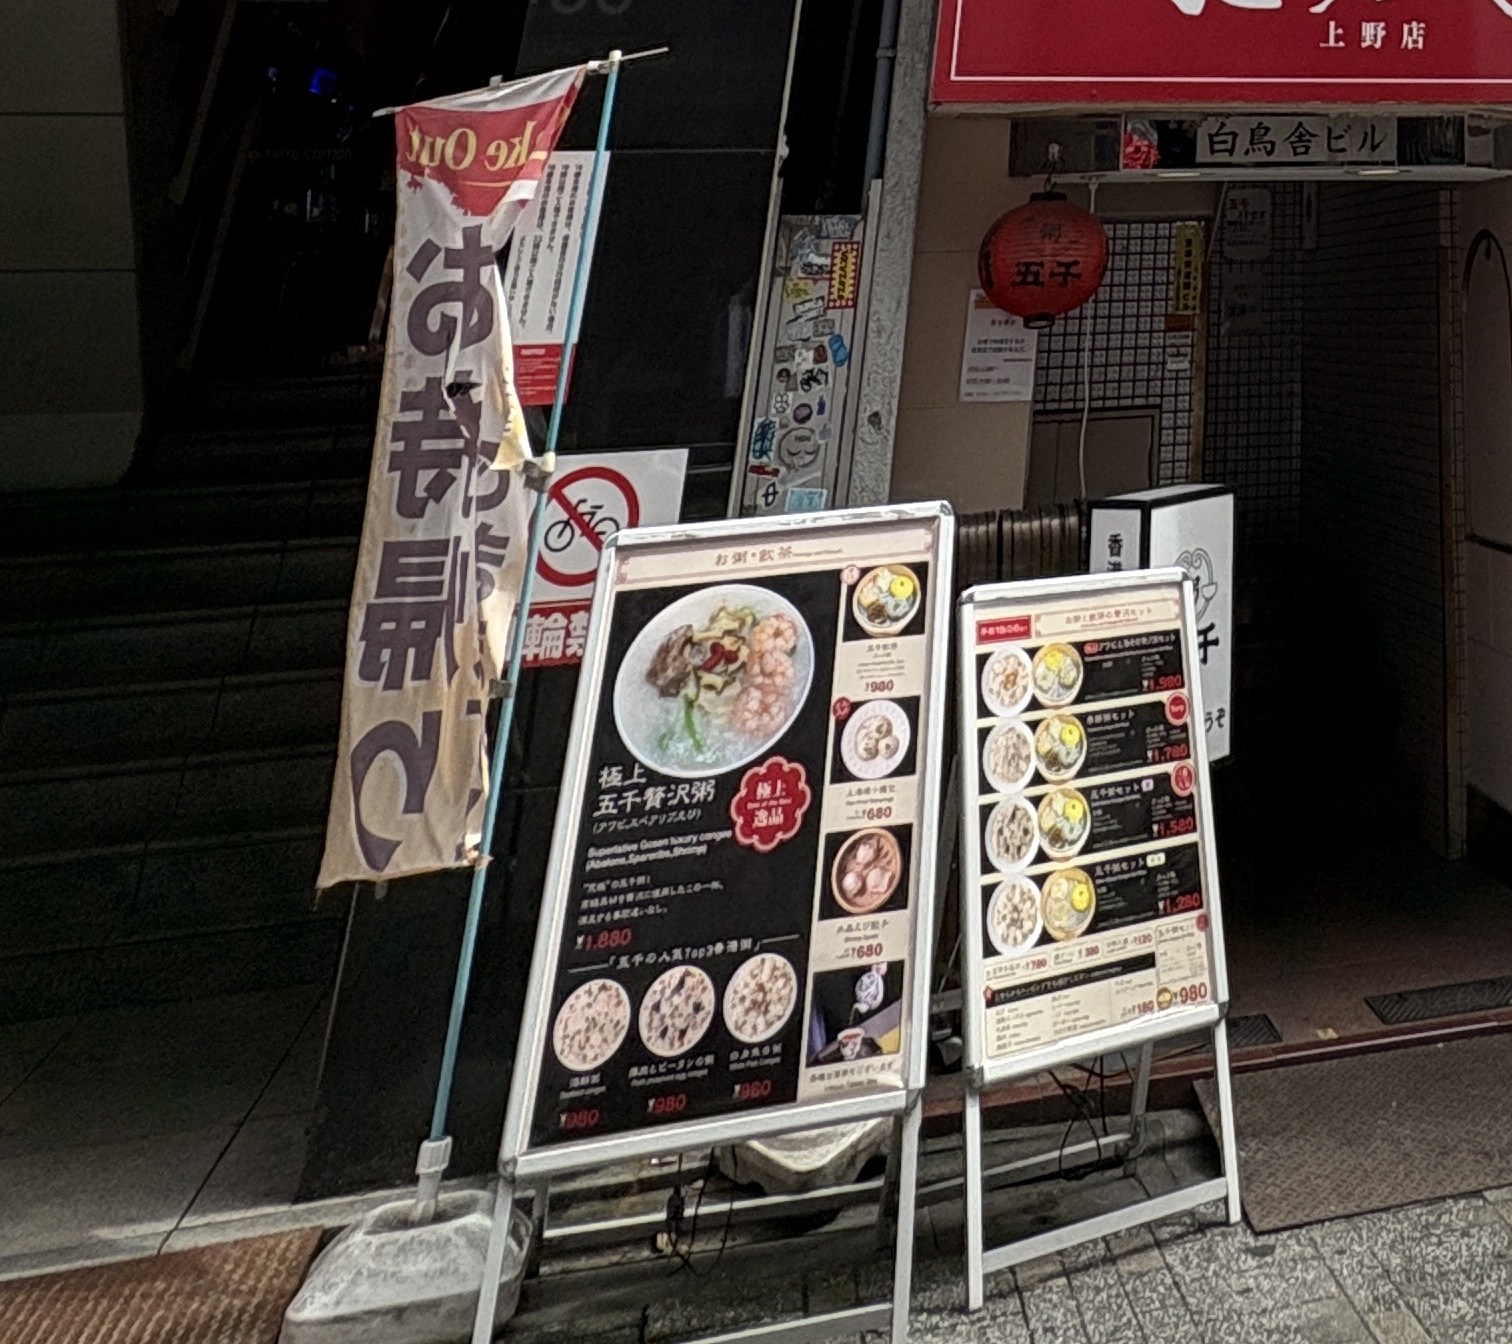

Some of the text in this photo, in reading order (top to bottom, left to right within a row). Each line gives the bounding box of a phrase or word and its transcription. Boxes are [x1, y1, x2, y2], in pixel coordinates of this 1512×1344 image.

[1319, 19, 1427, 51] 上野店
[598, 764, 648, 790] 極上
